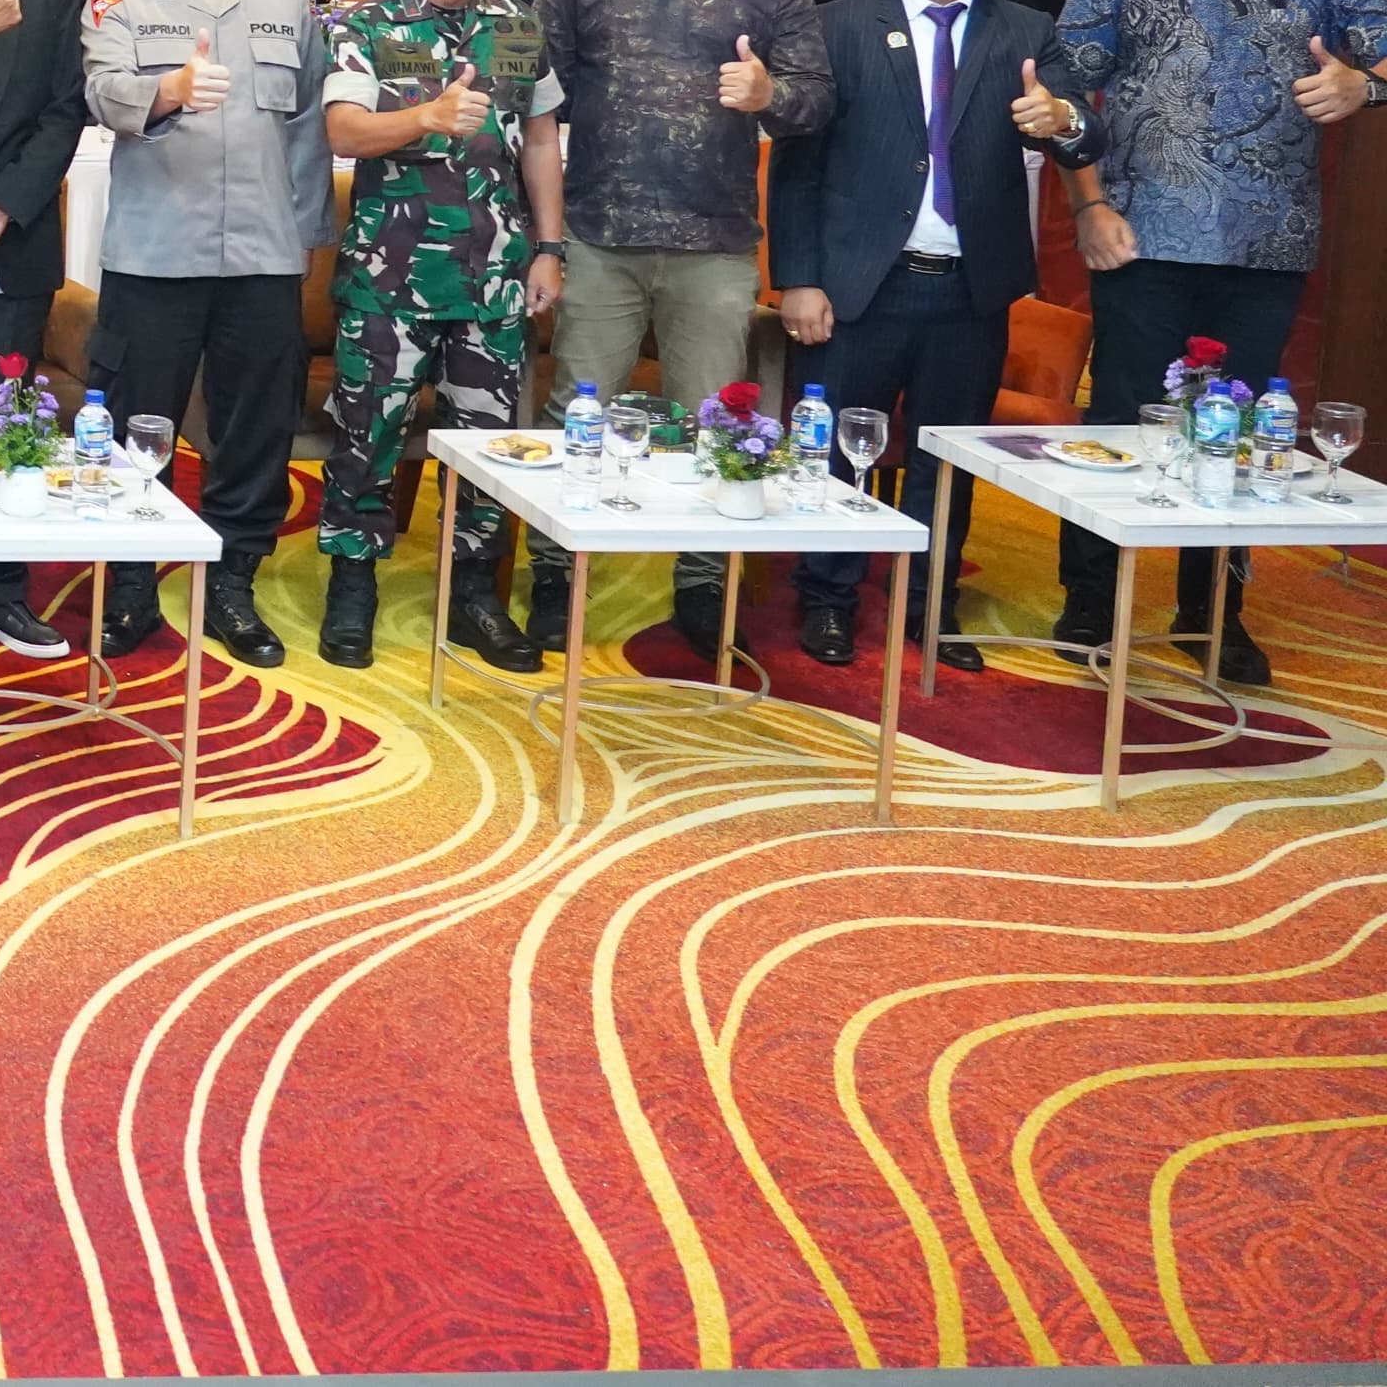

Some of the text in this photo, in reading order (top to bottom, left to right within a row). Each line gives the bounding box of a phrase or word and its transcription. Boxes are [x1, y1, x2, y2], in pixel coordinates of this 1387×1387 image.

[137, 23, 295, 37] SUPRIADI POLRI
[498, 61, 525, 74] TNI
